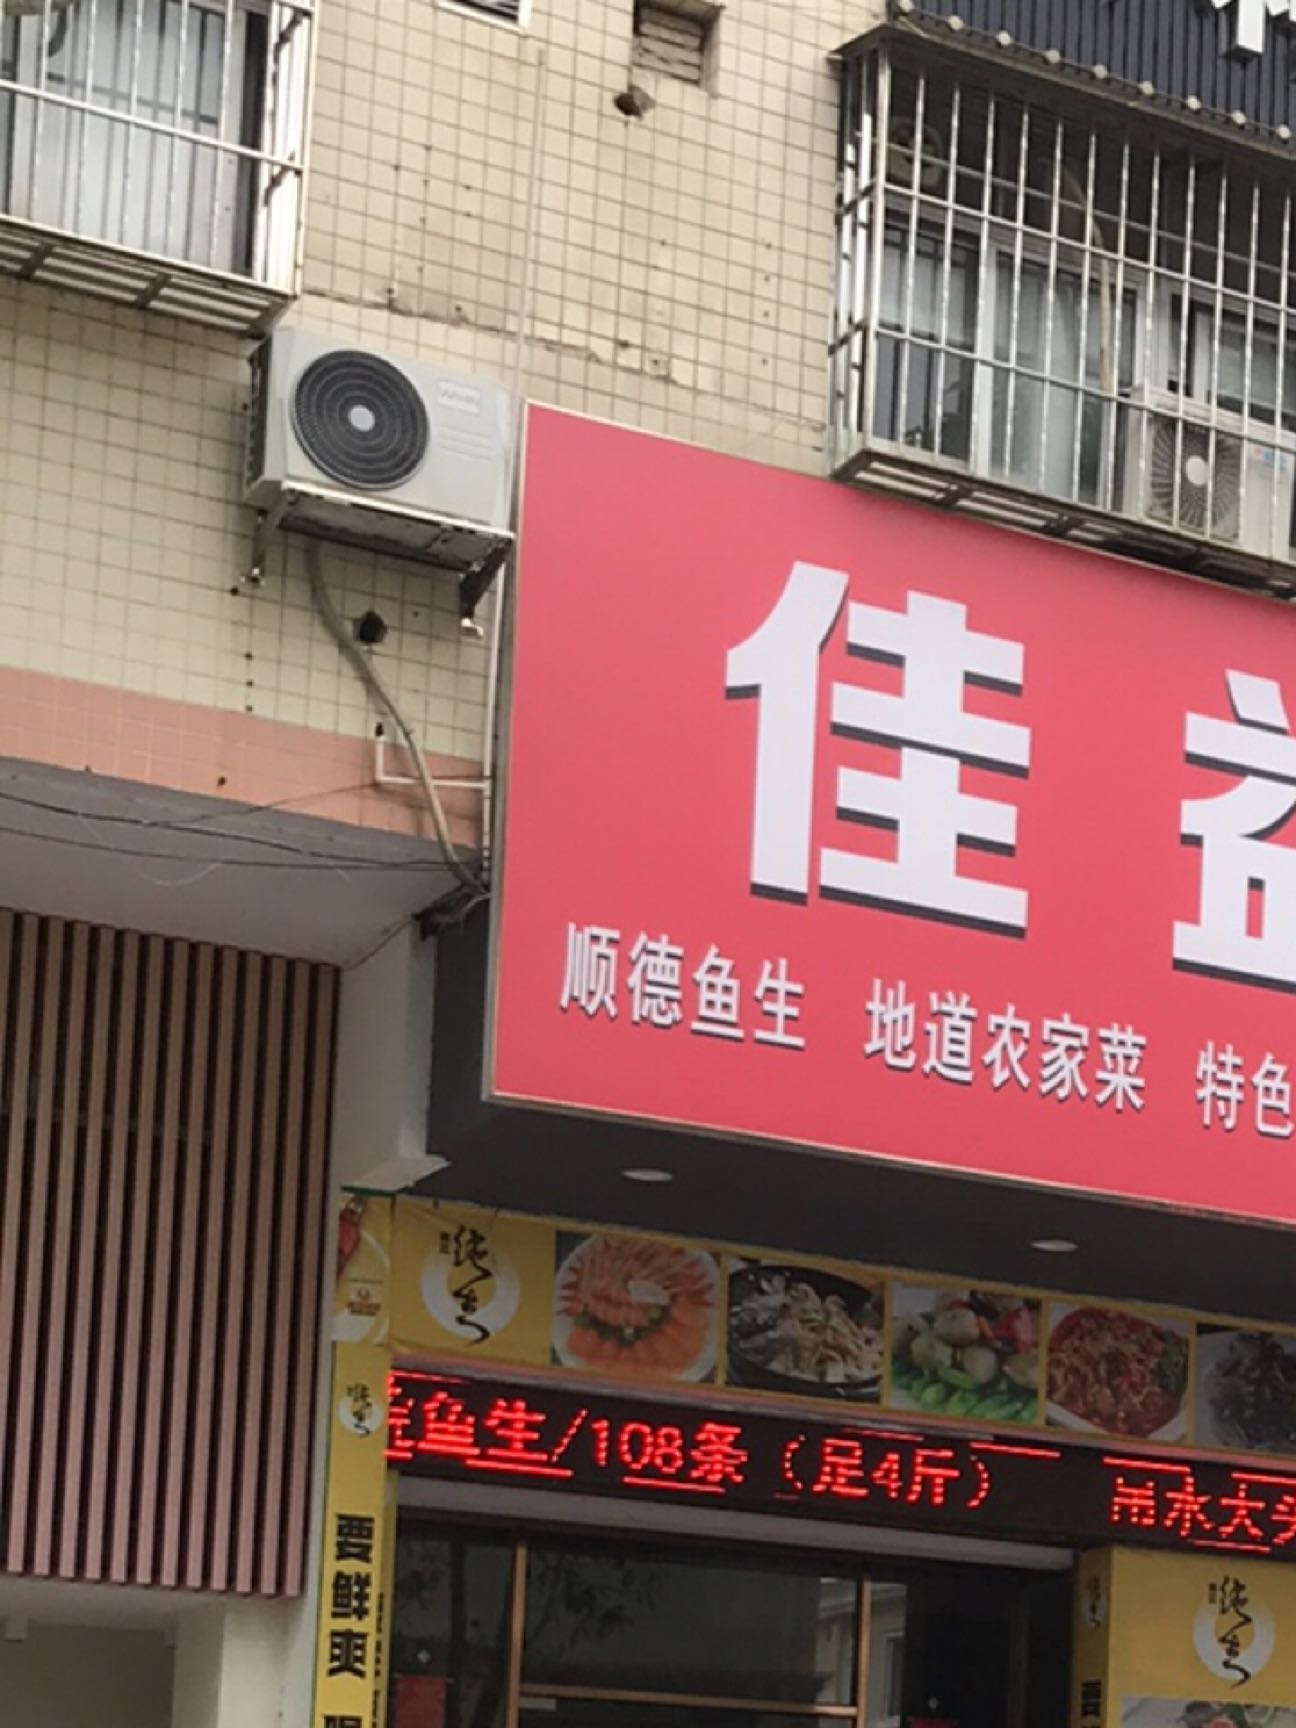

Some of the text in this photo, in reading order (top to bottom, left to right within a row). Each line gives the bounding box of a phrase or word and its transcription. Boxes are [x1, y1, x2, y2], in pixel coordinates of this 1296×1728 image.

[559, 922, 806, 1050] 顺德鱼生
[864, 978, 1147, 1110] 地道农家菜
[328, 1513, 375, 1679] 要鲜爽
